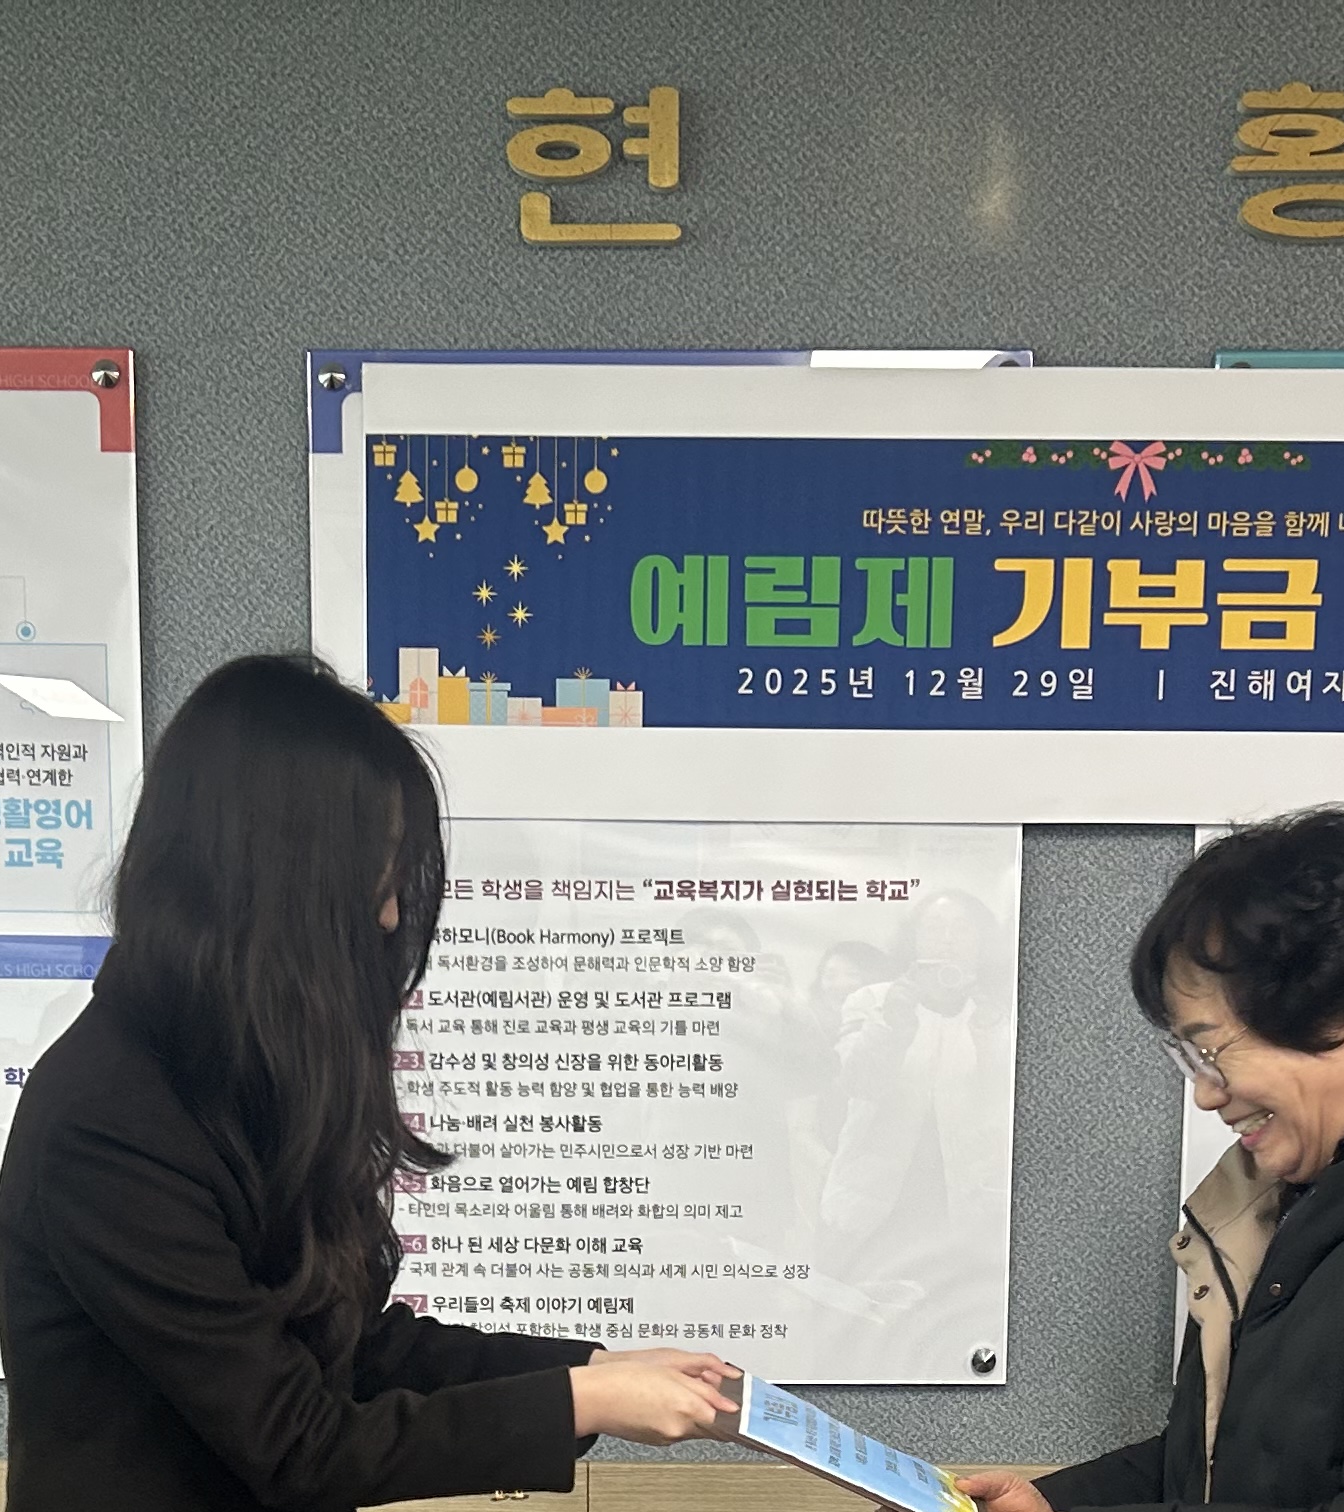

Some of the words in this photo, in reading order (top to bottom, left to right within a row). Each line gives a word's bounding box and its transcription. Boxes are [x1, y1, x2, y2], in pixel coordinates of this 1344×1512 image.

[506, 87, 681, 246] 현
[863, 509, 931, 534] 따뜻한
[940, 509, 990, 535] 연말,
[1000, 510, 1044, 535] 우리
[1055, 510, 1120, 536] 다같이
[1130, 511, 1197, 536] 사랑의
[1208, 511, 1276, 537] 마음을
[1285, 512, 1329, 537] 함께
[631, 555, 953, 648] 예림제
[993, 558, 1322, 650] 기부금
[738, 667, 873, 697] 2025년
[906, 668, 982, 699] 12월
[1013, 668, 1093, 699] 29일
[41, 744, 88, 762] 자원과
[5, 838, 64, 869] 교육
[482, 880, 543, 900] 학생을
[552, 880, 635, 900] 책임지는
[771, 880, 858, 901] 실현되는
[540, 929, 614, 948] Harmony)
[620, 929, 685, 946] 프로젝트
[17, 964, 50, 977] HIGH
[558, 991, 588, 1008] 운영
[595, 991, 609, 1009] 및
[615, 991, 663, 1009] 도서관
[668, 992, 731, 1009] 프로그램
[432, 1236, 463, 1253] 하나
[468, 1237, 482, 1253] 된
[488, 1237, 519, 1253] 세상
[525, 1237, 571, 1254] 다문화
[577, 1237, 606, 1254] 이해
[612, 1238, 643, 1254] 교육
